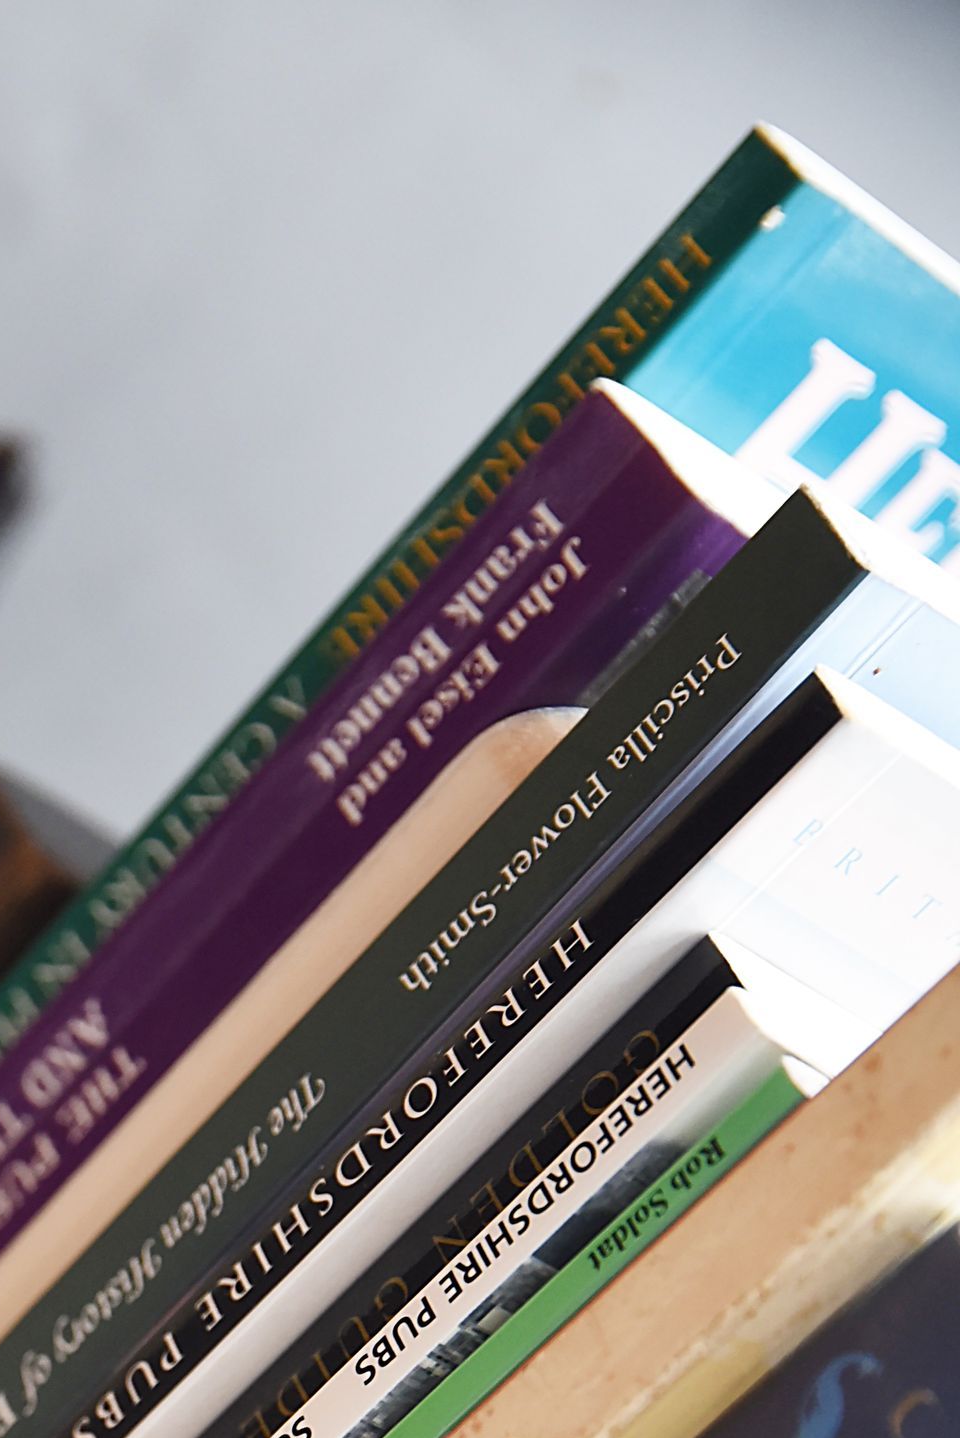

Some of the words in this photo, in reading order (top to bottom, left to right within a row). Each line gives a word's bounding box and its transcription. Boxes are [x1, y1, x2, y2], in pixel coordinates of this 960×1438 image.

[441, 499, 565, 628] Frank
[494, 534, 591, 642] John
[267, 673, 312, 724] A
[306, 625, 452, 782] Bennett
[406, 642, 501, 746] Eisel
[606, 632, 742, 772] Priscilla
[335, 736, 409, 825] and
[398, 769, 612, 994] Flower-Smith
[792, 817, 959, 950] PRIT
[11, 994, 121, 1115] AND
[54, 1044, 146, 1140] THE
[266, 1072, 328, 1138] The
[192, 917, 594, 1331] HEREFORDSHIRE
[424, 1026, 665, 1263] GOLDEN
[436, 1042, 696, 1304] HEREFORDSHIRE
[668, 1136, 726, 1192] Rob
[158, 1125, 272, 1250] Hidden
[586, 1187, 670, 1271] Soldat
[48, 1240, 163, 1363] History
[352, 1295, 438, 1385] PUBS
[4, 1348, 64, 1412] of
